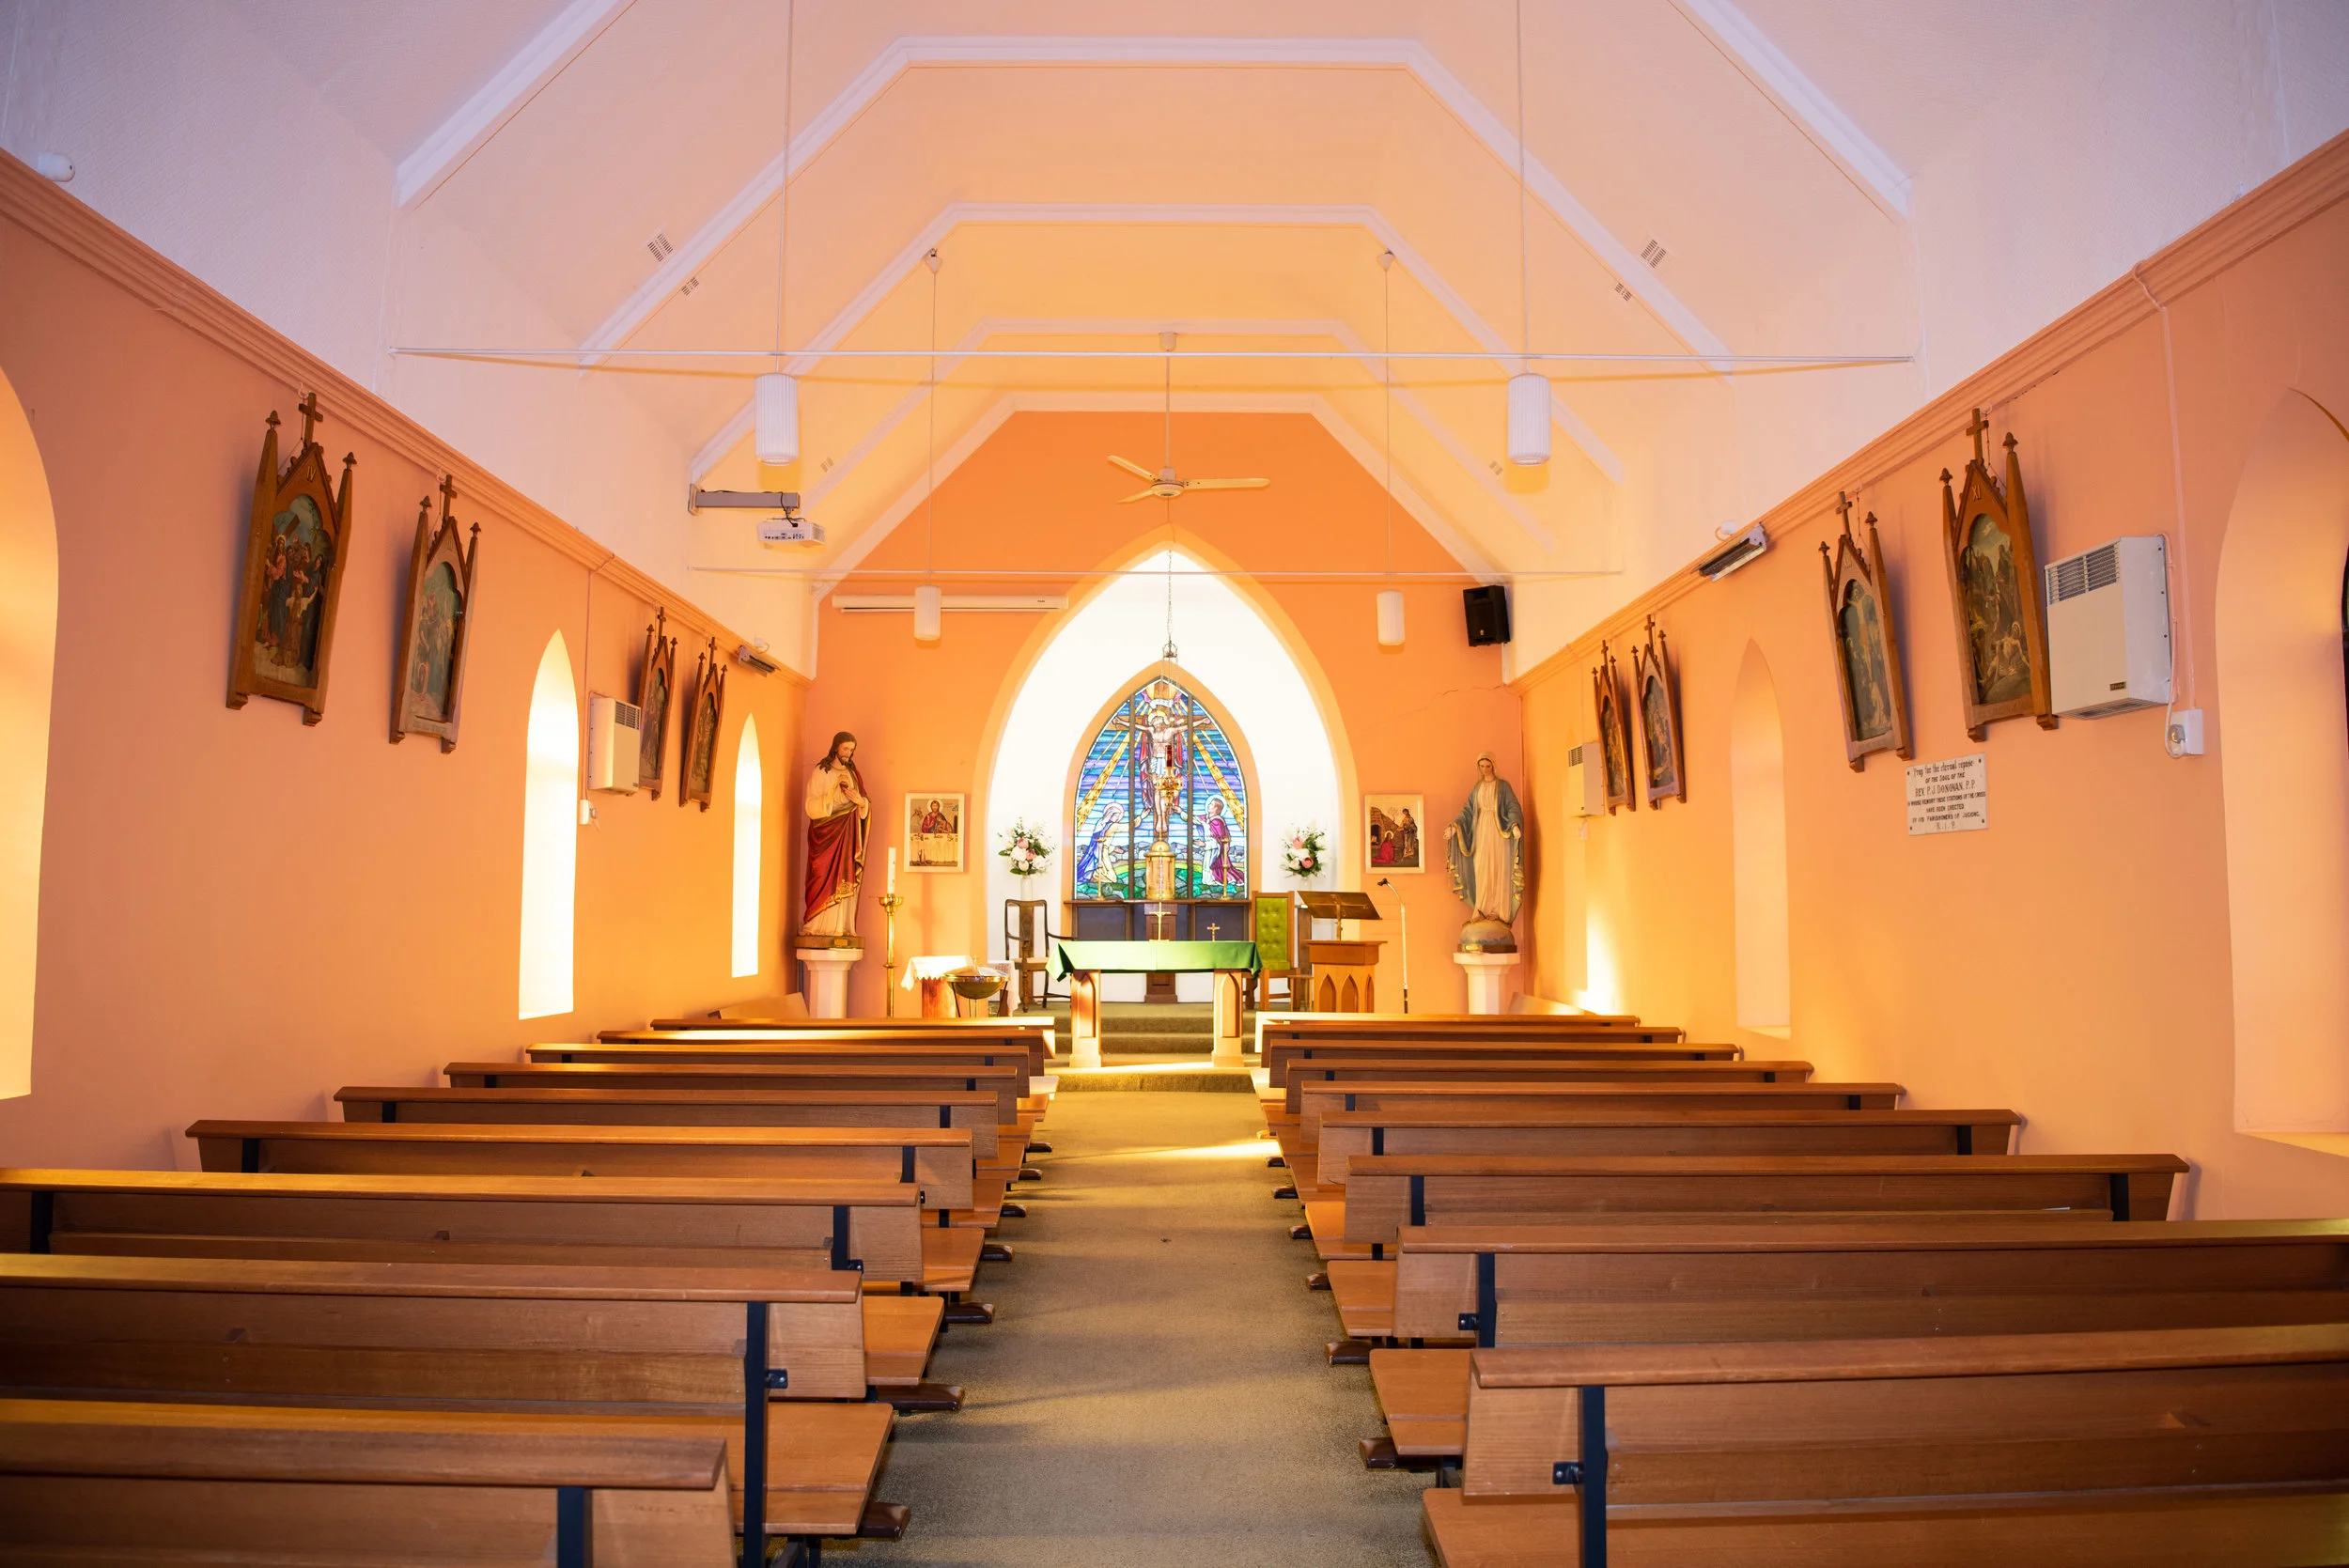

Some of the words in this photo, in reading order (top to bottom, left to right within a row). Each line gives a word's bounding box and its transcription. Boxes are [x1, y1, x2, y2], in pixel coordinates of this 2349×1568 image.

[306, 464, 318, 482] IV
[1971, 484, 1981, 500] XI
[1940, 760, 1956, 771] eternal
[1958, 760, 1973, 771] repose
